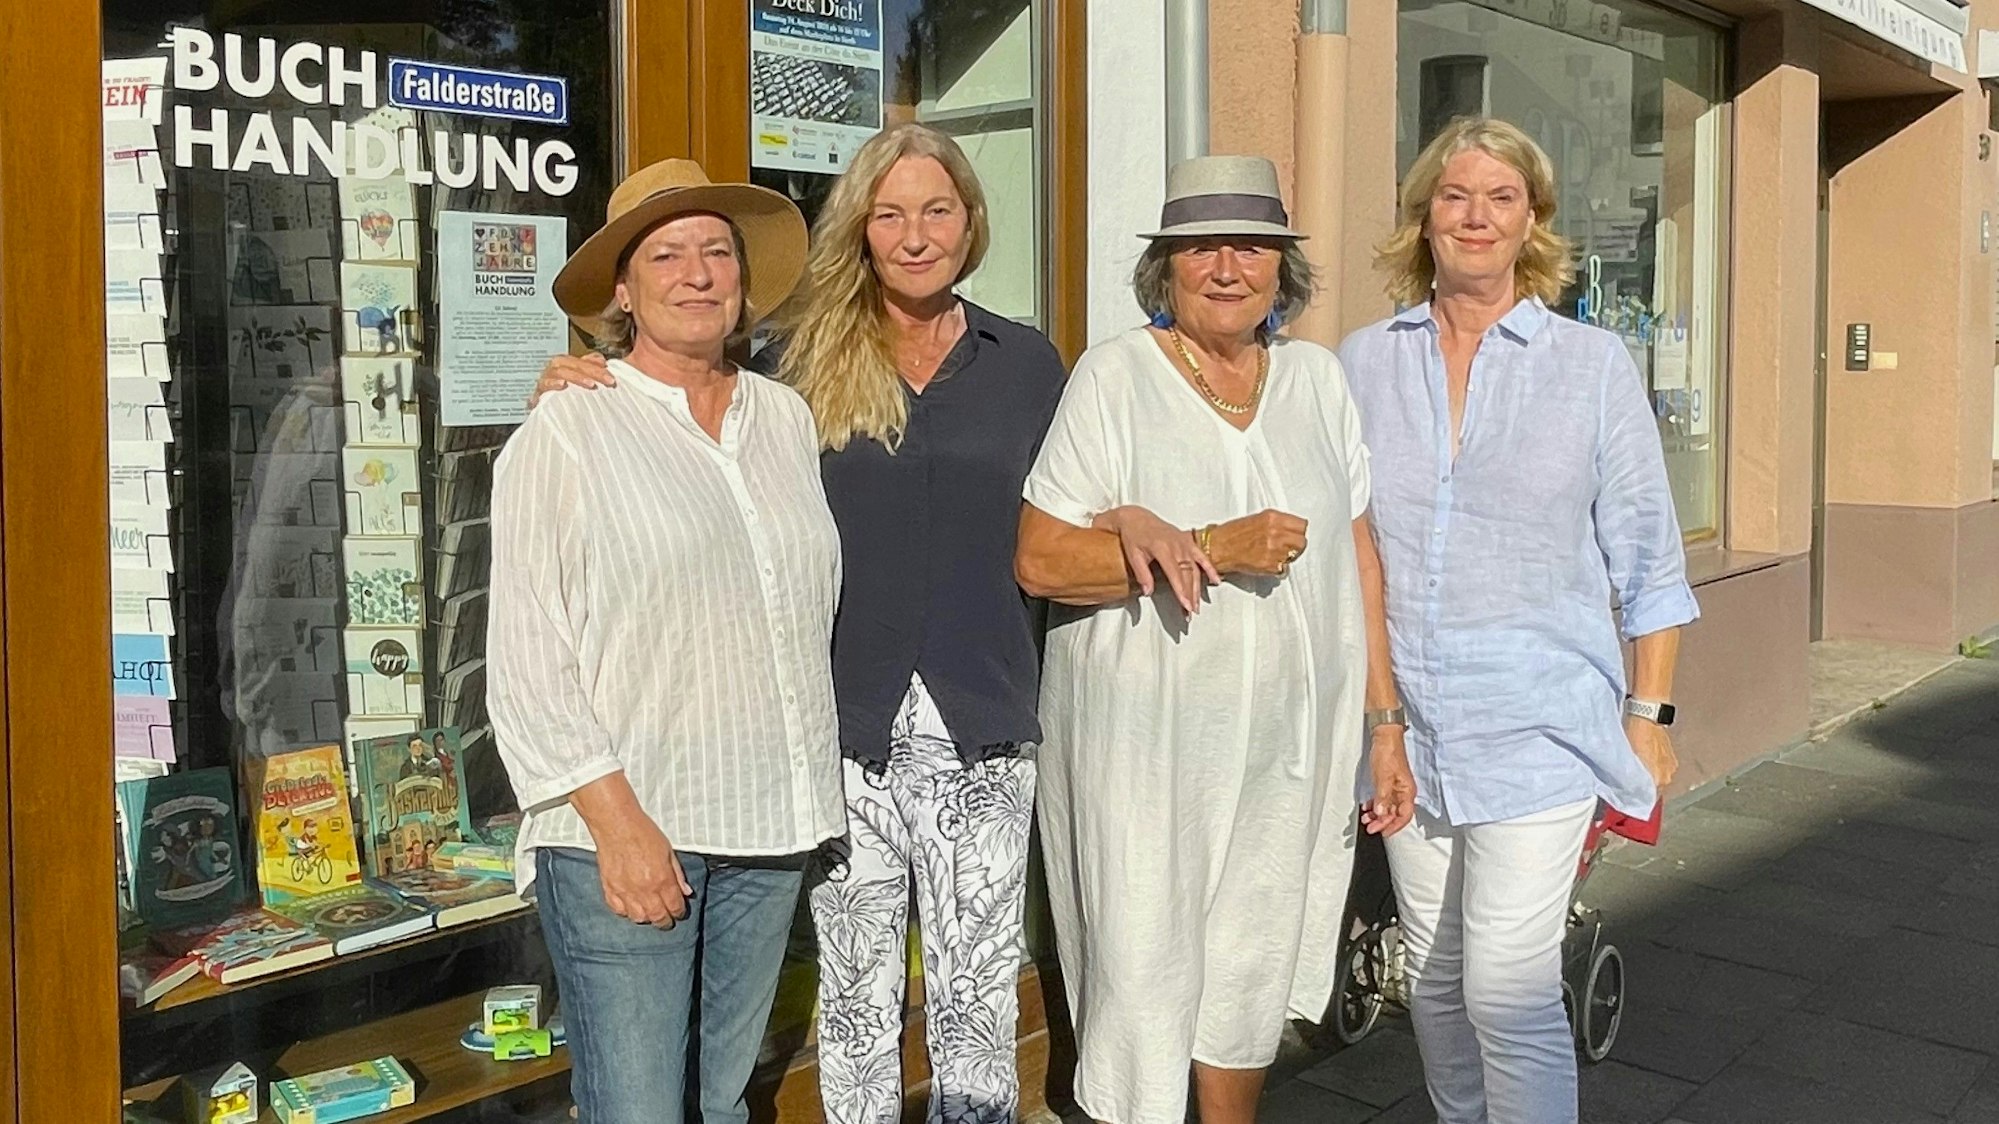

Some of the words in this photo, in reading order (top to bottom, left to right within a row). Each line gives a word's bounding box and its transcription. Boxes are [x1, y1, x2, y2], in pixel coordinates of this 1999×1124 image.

[820, 0, 862, 22] Dich!
[173, 26, 377, 109] BUCH
[403, 69, 556, 114] Falderstraße
[174, 105, 579, 197] HANDLUNG
[476, 256, 533, 269] JAHRE
[475, 274, 503, 285] BUCH
[475, 286, 535, 297] HANDLUNG
[114, 661, 164, 681] HOI
[371, 649, 408, 672] happy
